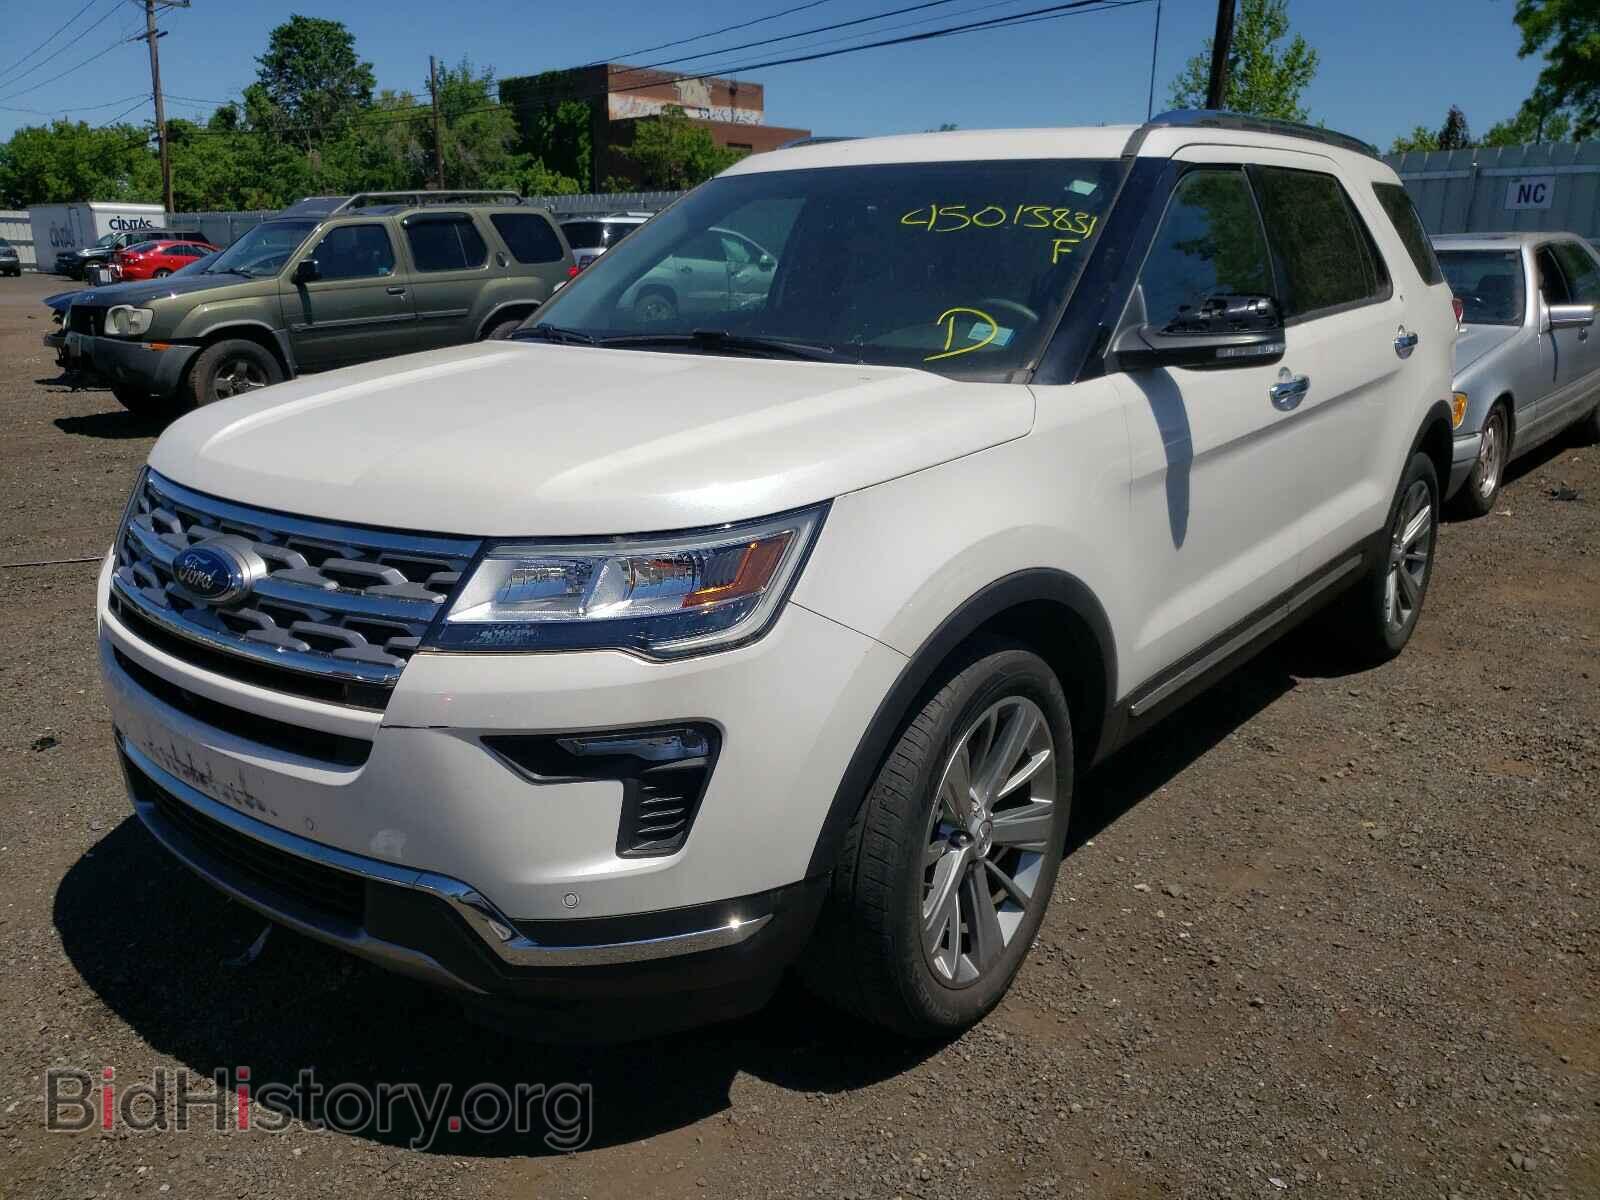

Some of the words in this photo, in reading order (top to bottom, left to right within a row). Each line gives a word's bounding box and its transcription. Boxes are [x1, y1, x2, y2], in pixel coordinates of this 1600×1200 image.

[1516, 183, 1546, 204] NC
[109, 216, 153, 231] CINTAS
[1052, 238, 1081, 264] F
[923, 306, 998, 361] D
[179, 553, 219, 590] Ford
